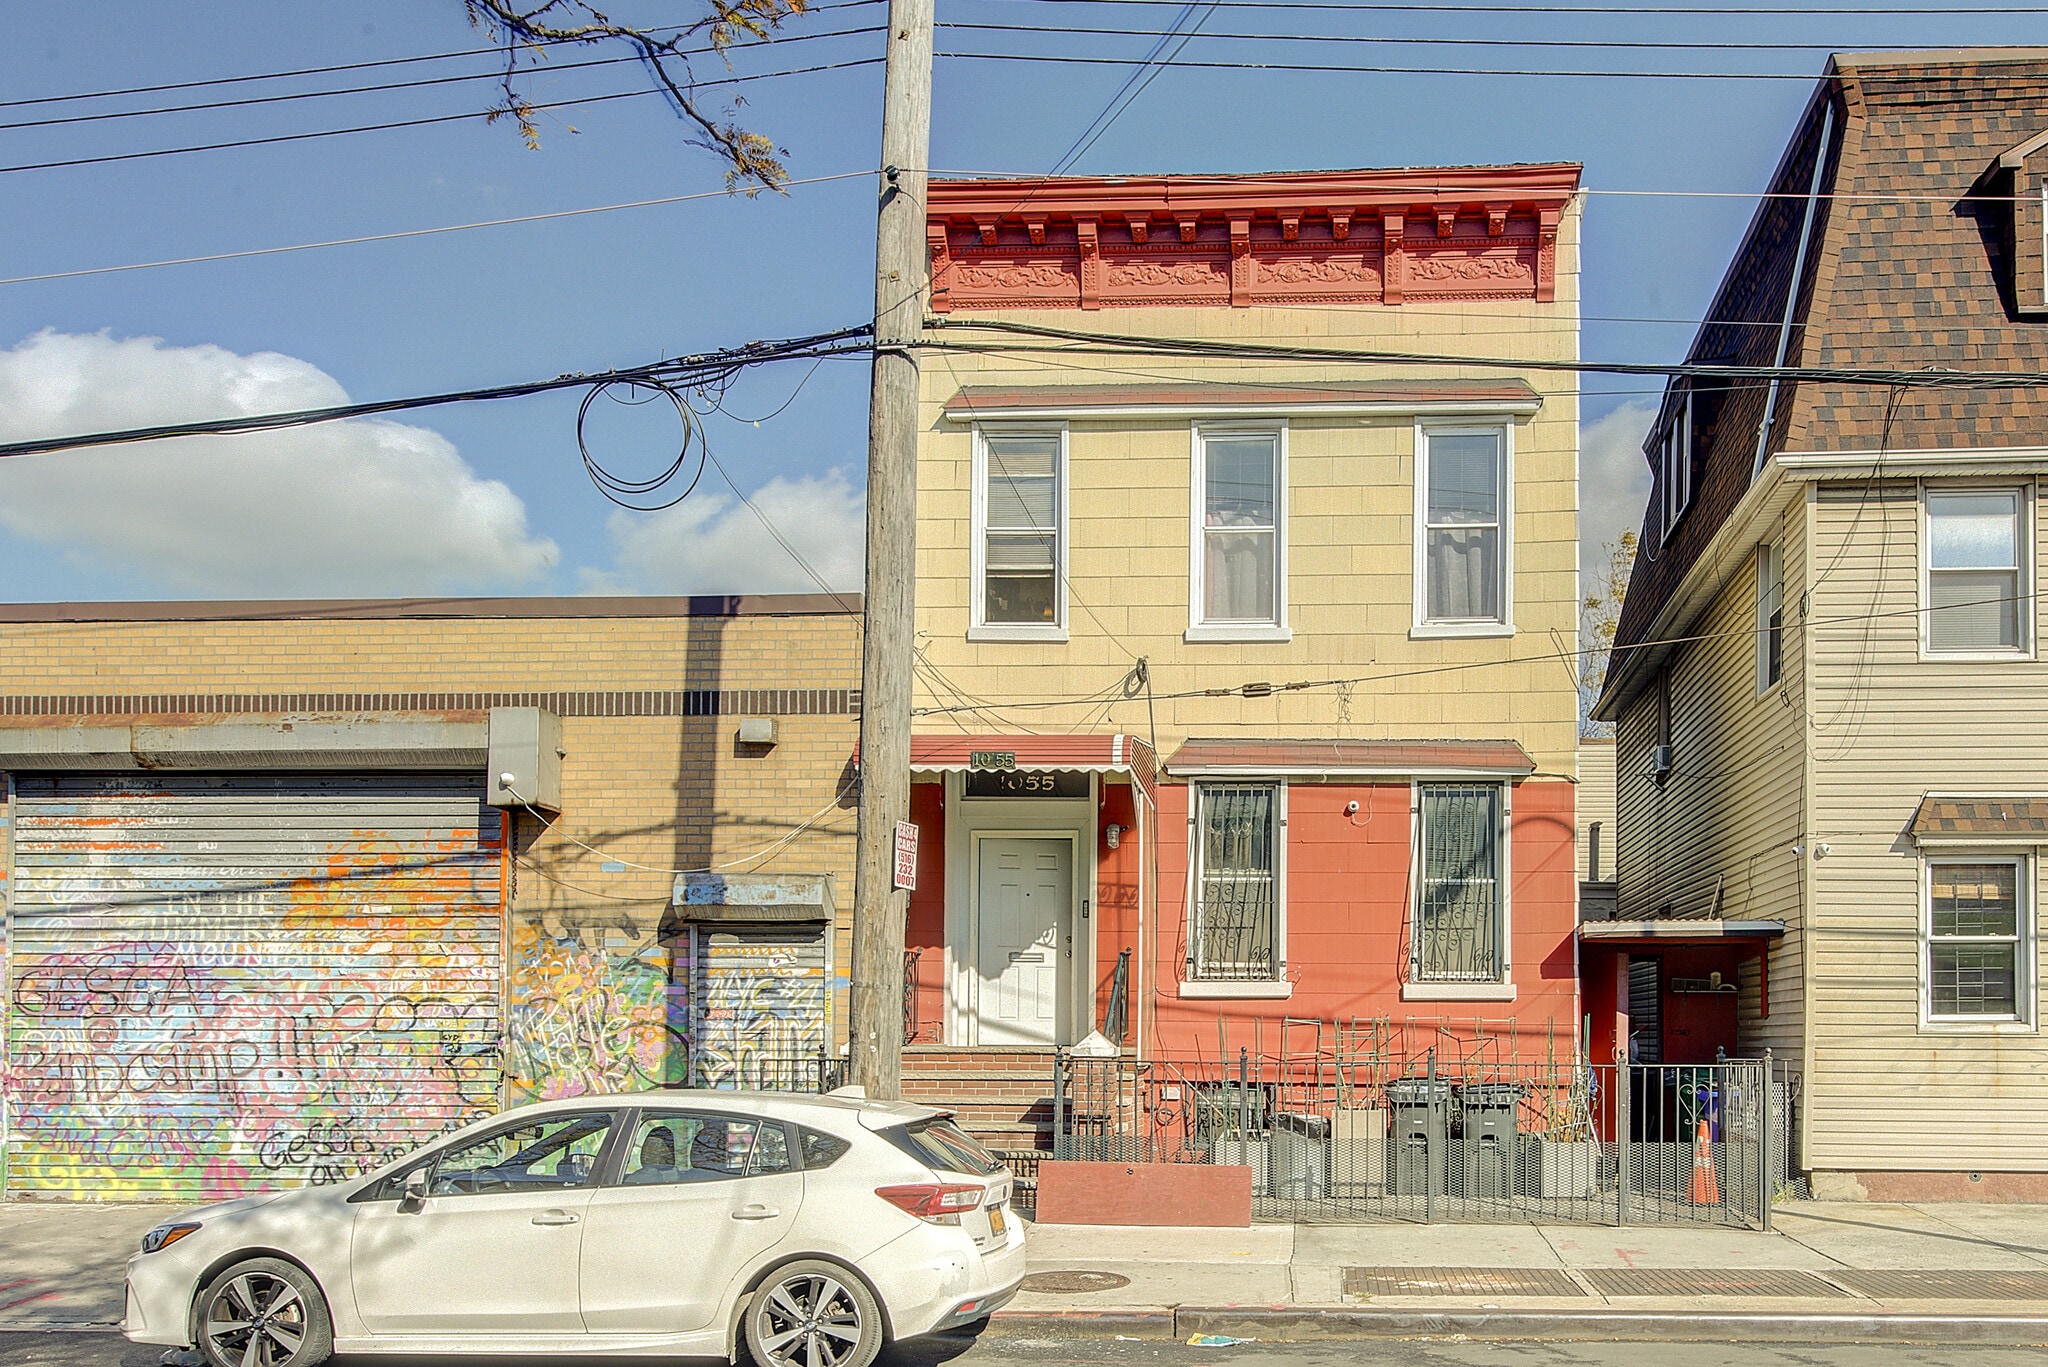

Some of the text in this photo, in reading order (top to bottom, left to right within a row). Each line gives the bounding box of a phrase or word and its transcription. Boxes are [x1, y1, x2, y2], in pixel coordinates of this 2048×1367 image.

[898, 838, 916, 852] CARS
[898, 851, 915, 865] (516)
[898, 862, 913, 875] 232
[896, 873, 915, 887] 0007
